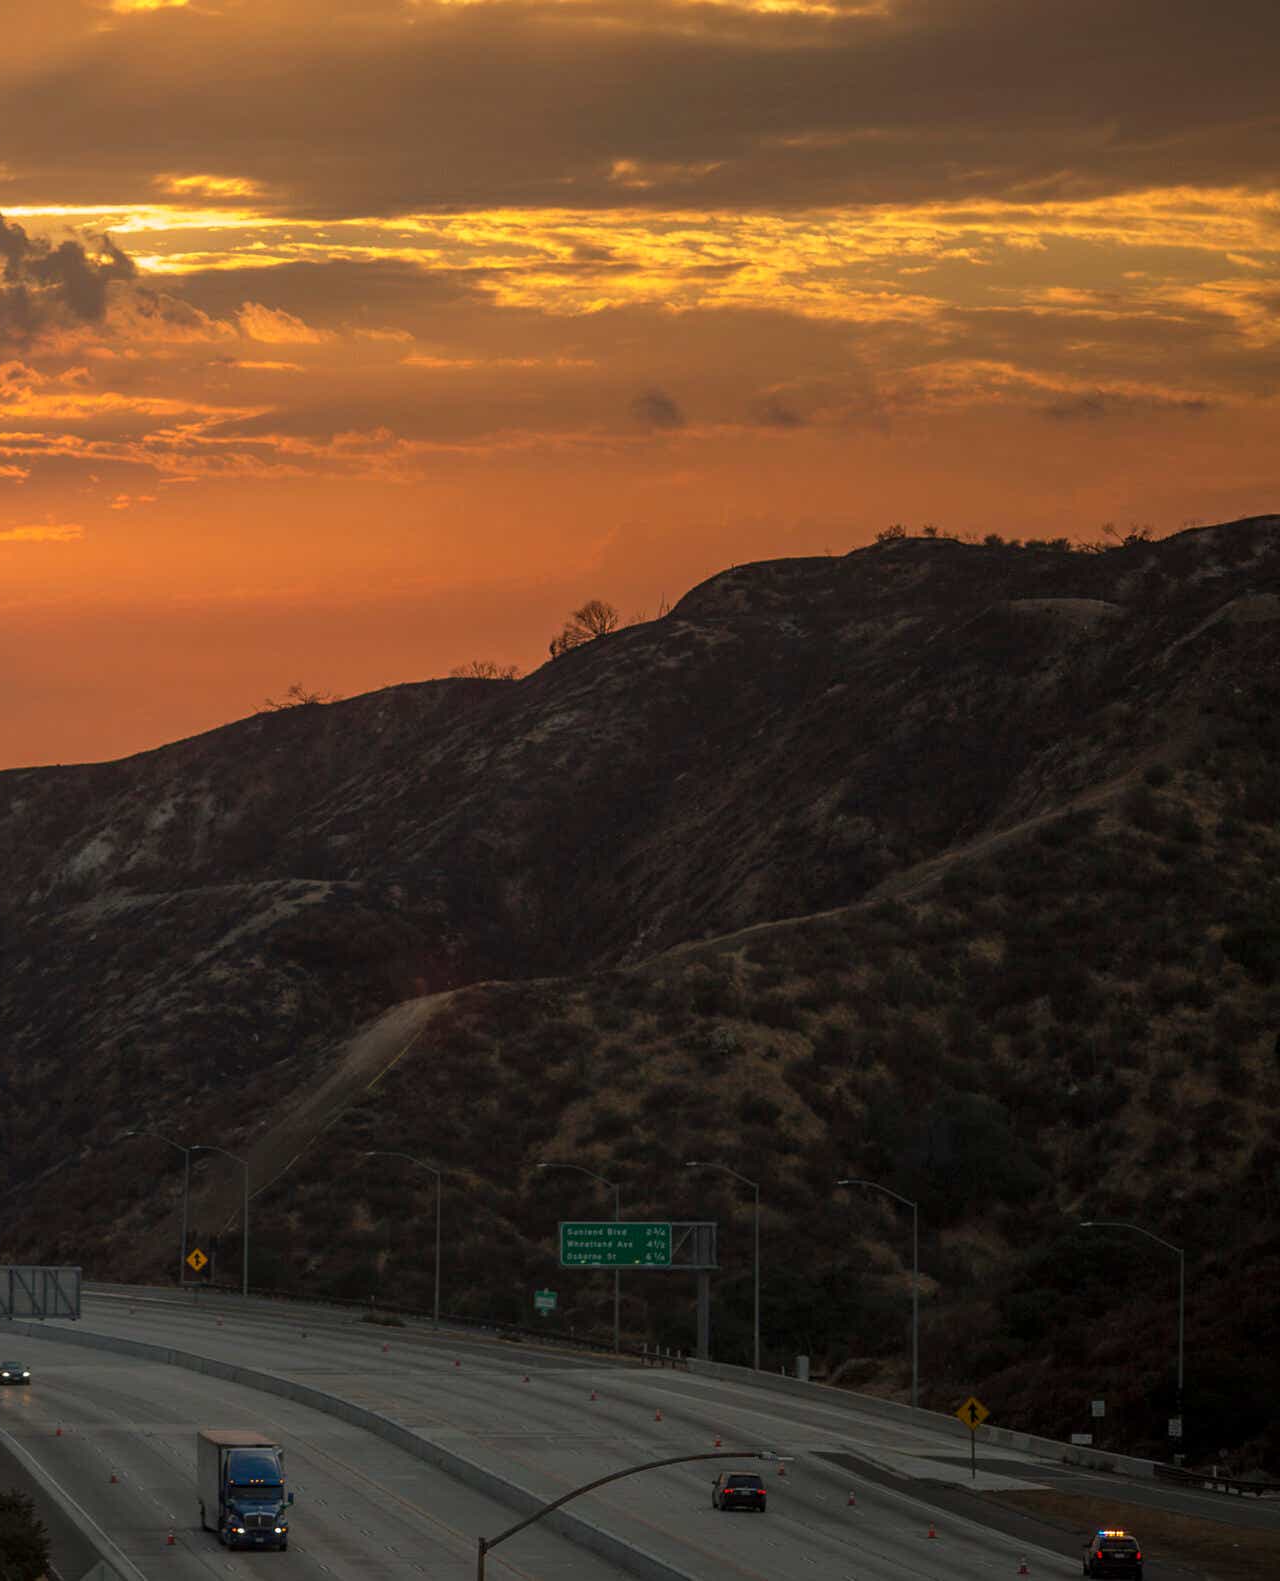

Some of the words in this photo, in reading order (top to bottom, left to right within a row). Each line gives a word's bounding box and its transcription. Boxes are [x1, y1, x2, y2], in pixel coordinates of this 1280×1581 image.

[567, 1228, 603, 1236] Sunland
[607, 1228, 627, 1236] Blvd
[567, 1240, 613, 1248] Wheatland
[617, 1240, 633, 1248] Ave
[567, 1252, 602, 1260] Osborne
[607, 1252, 617, 1260] St
